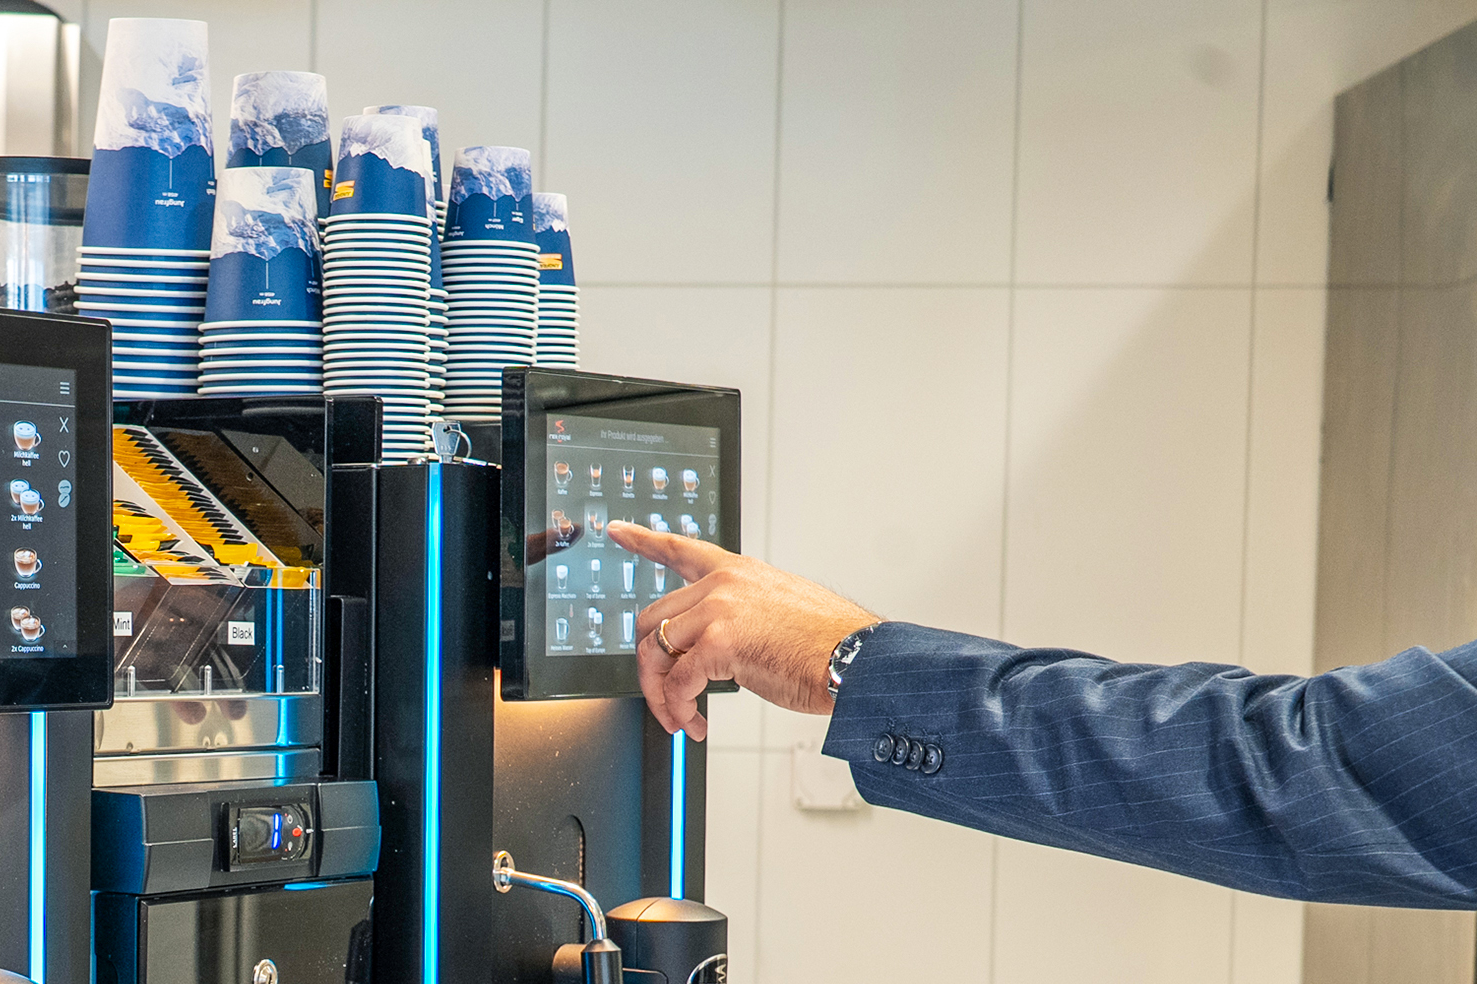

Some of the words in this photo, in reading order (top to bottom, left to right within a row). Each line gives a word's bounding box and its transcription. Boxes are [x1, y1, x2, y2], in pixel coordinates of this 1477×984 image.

[155, 198, 185, 207] Jungfrau
[252, 298, 282, 306] Jungfrau
[608, 431, 626, 440] Produkt
[626, 432, 637, 441] wird
[13, 451, 40, 460] Milchkaffee
[21, 459, 32, 467] hell
[11, 514, 17, 522] 2x
[17, 514, 43, 523] Milchkaffee
[22, 522, 32, 530] hell
[14, 582, 41, 590] Cappuccino
[232, 626, 253, 639] Black
[18, 645, 44, 653] Cappuccino
